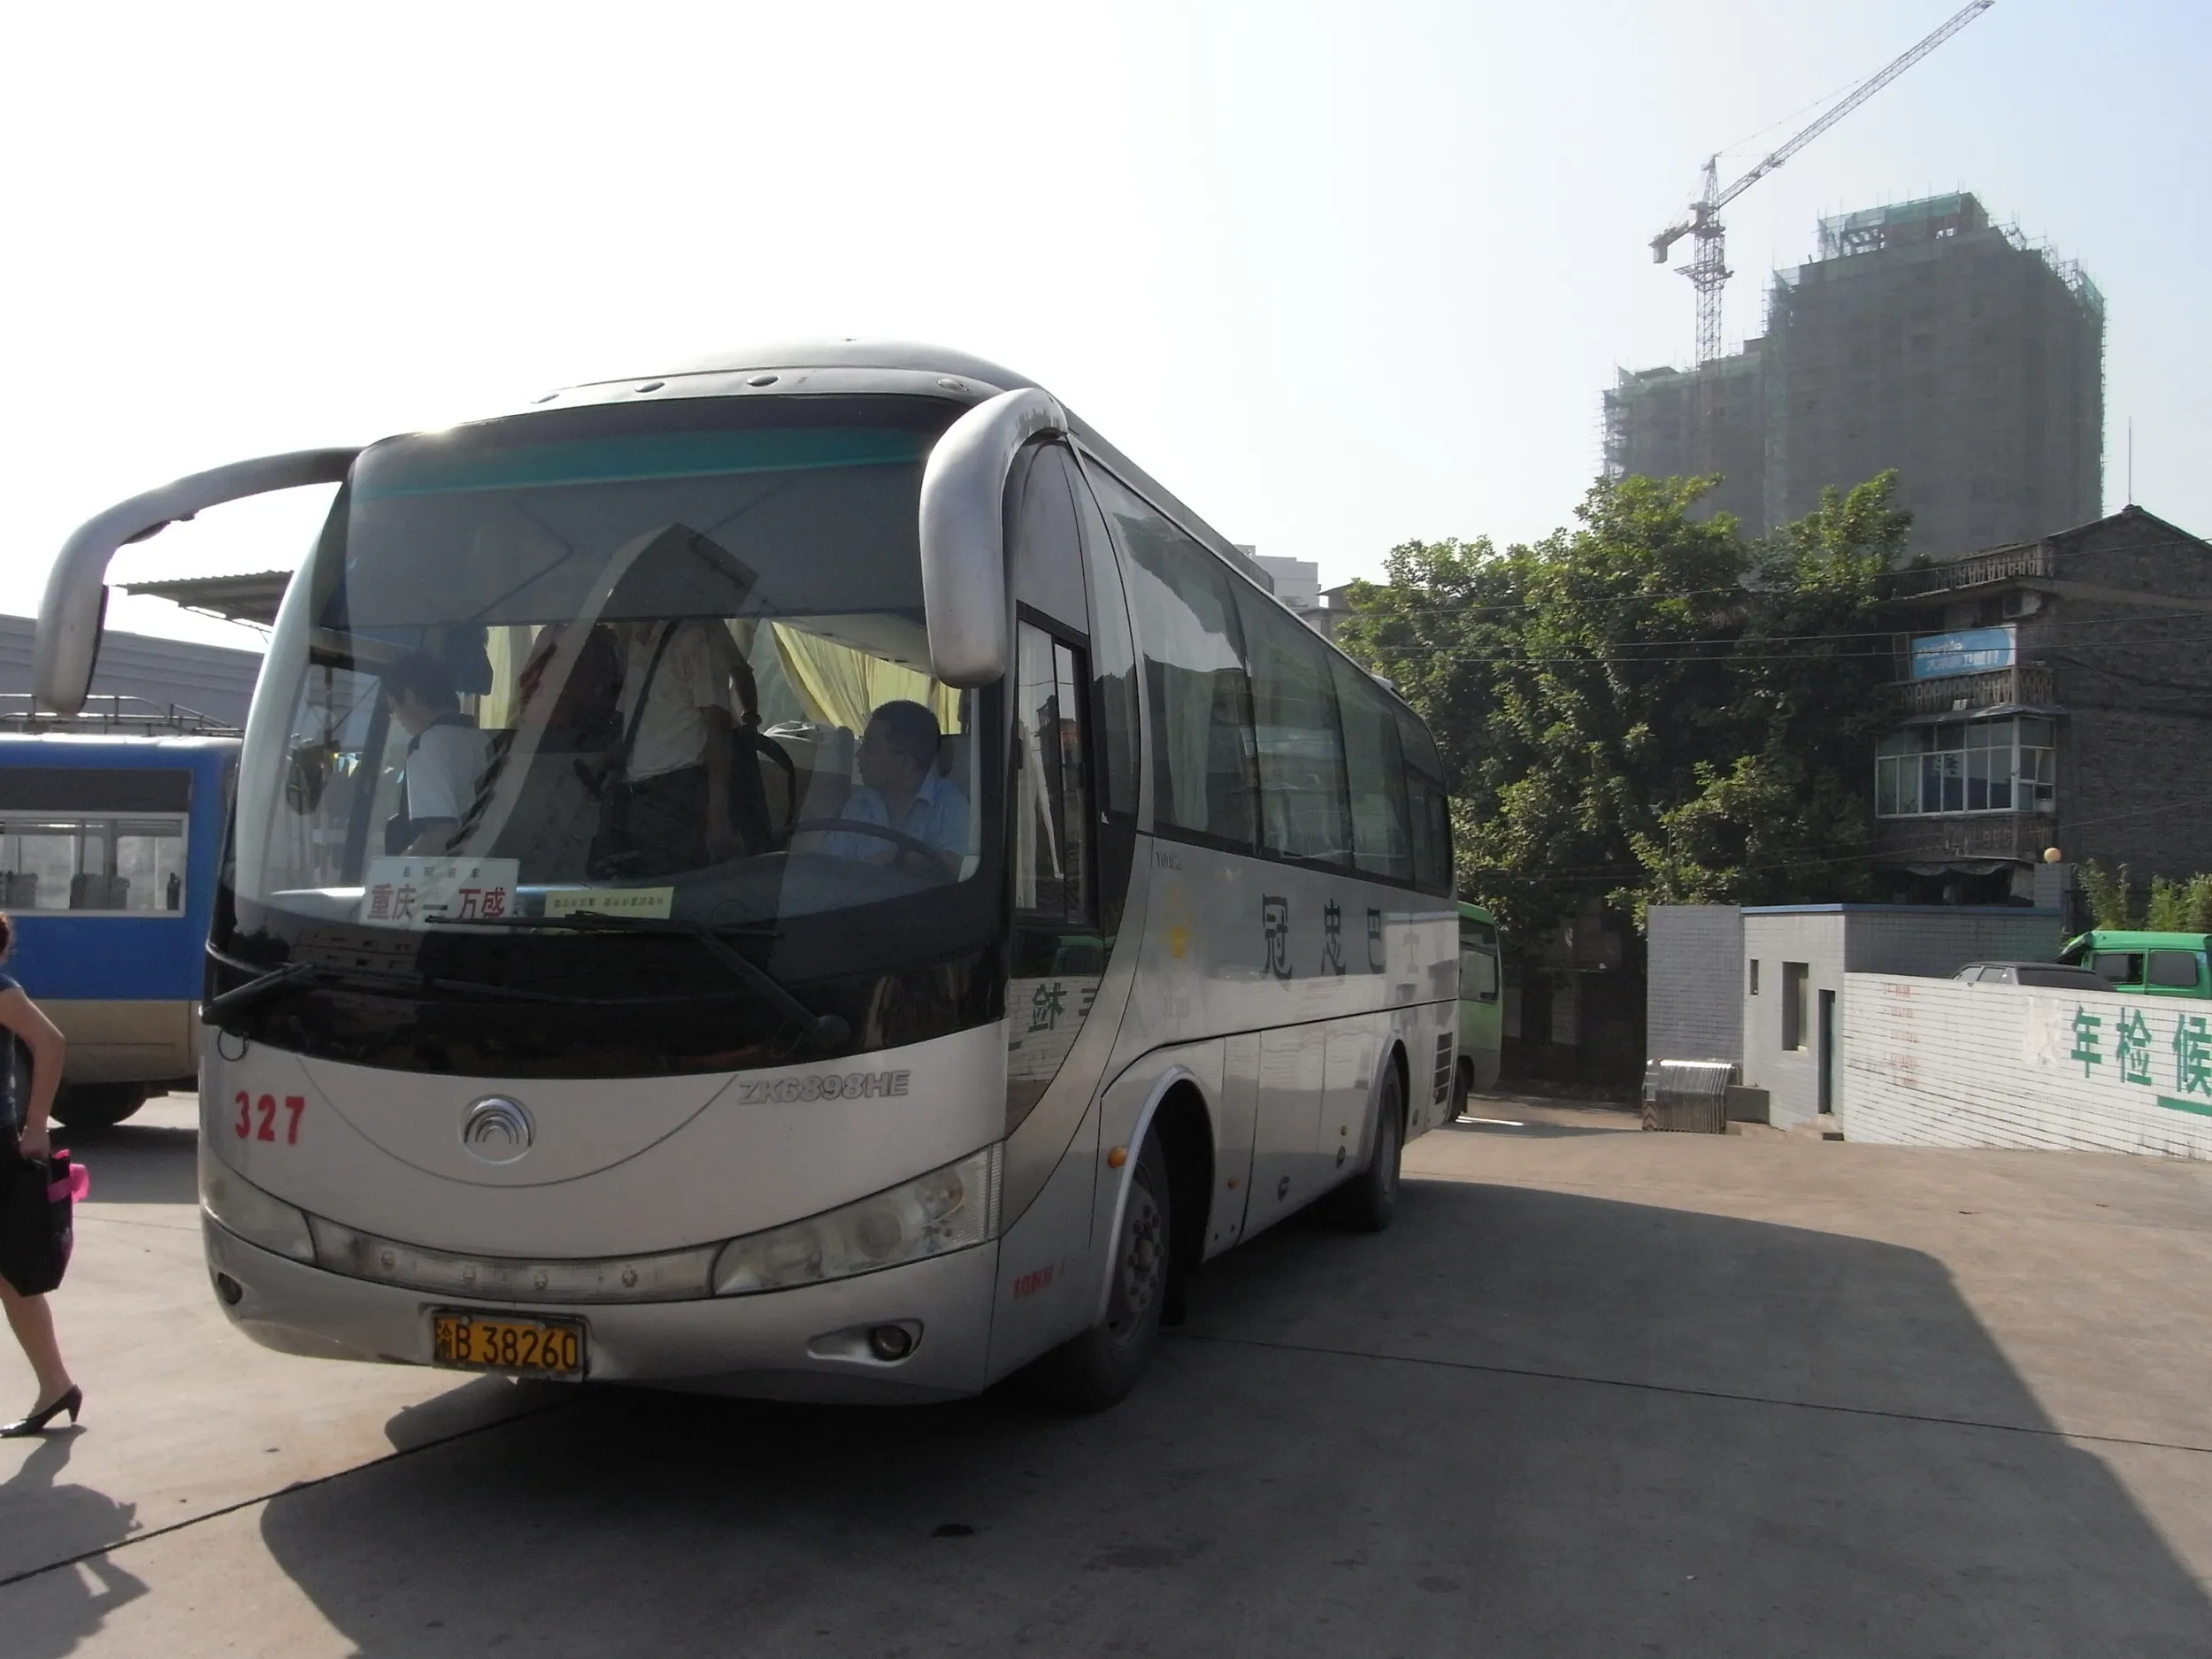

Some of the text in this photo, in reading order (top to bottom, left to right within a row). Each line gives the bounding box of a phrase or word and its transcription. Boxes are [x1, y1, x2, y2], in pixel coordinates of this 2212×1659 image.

[2070, 1004, 2212, 1098] 年检候
[737, 1069, 912, 1105] ZK6898HE
[234, 1089, 305, 1146] 327
